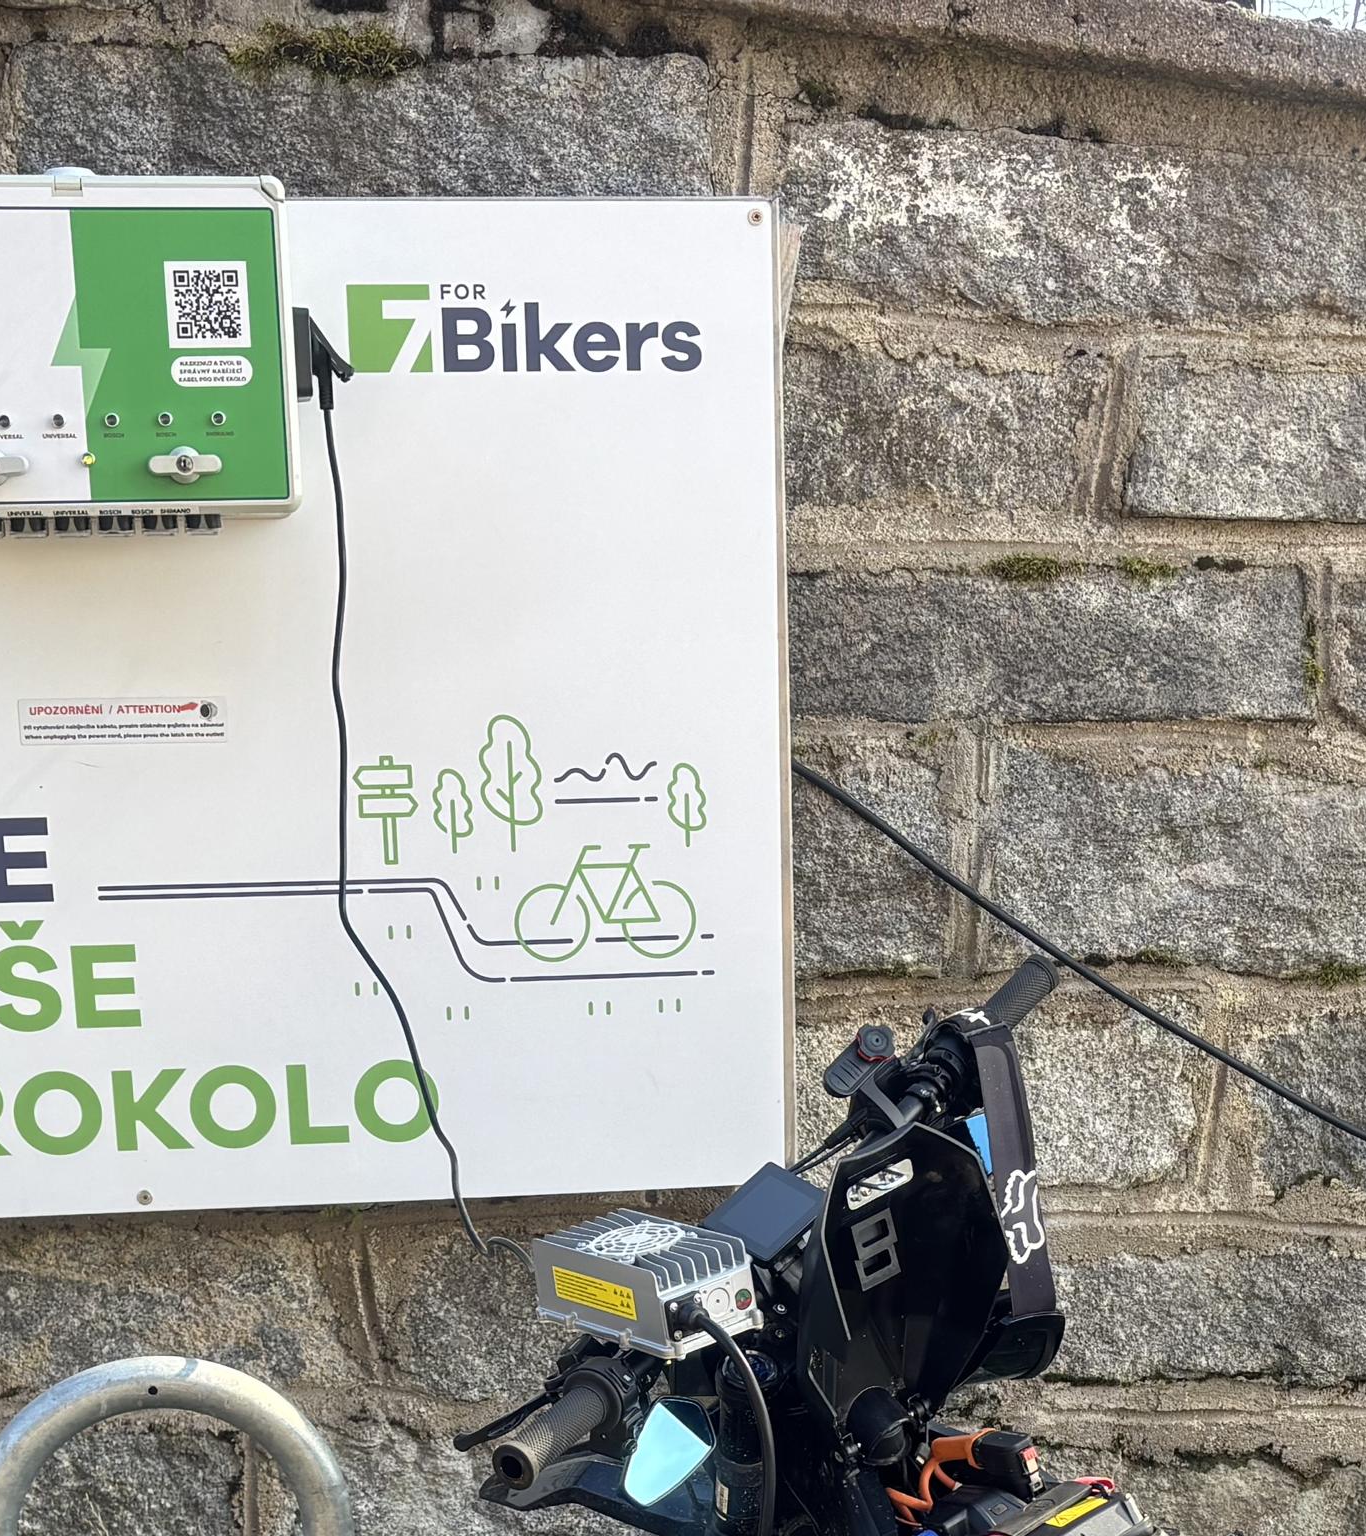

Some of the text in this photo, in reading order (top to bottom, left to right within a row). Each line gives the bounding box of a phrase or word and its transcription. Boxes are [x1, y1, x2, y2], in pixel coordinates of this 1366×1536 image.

[440, 284, 486, 299] FOR
[441, 298, 703, 373] Bikers
[117, 704, 181, 715] ATTENTION
